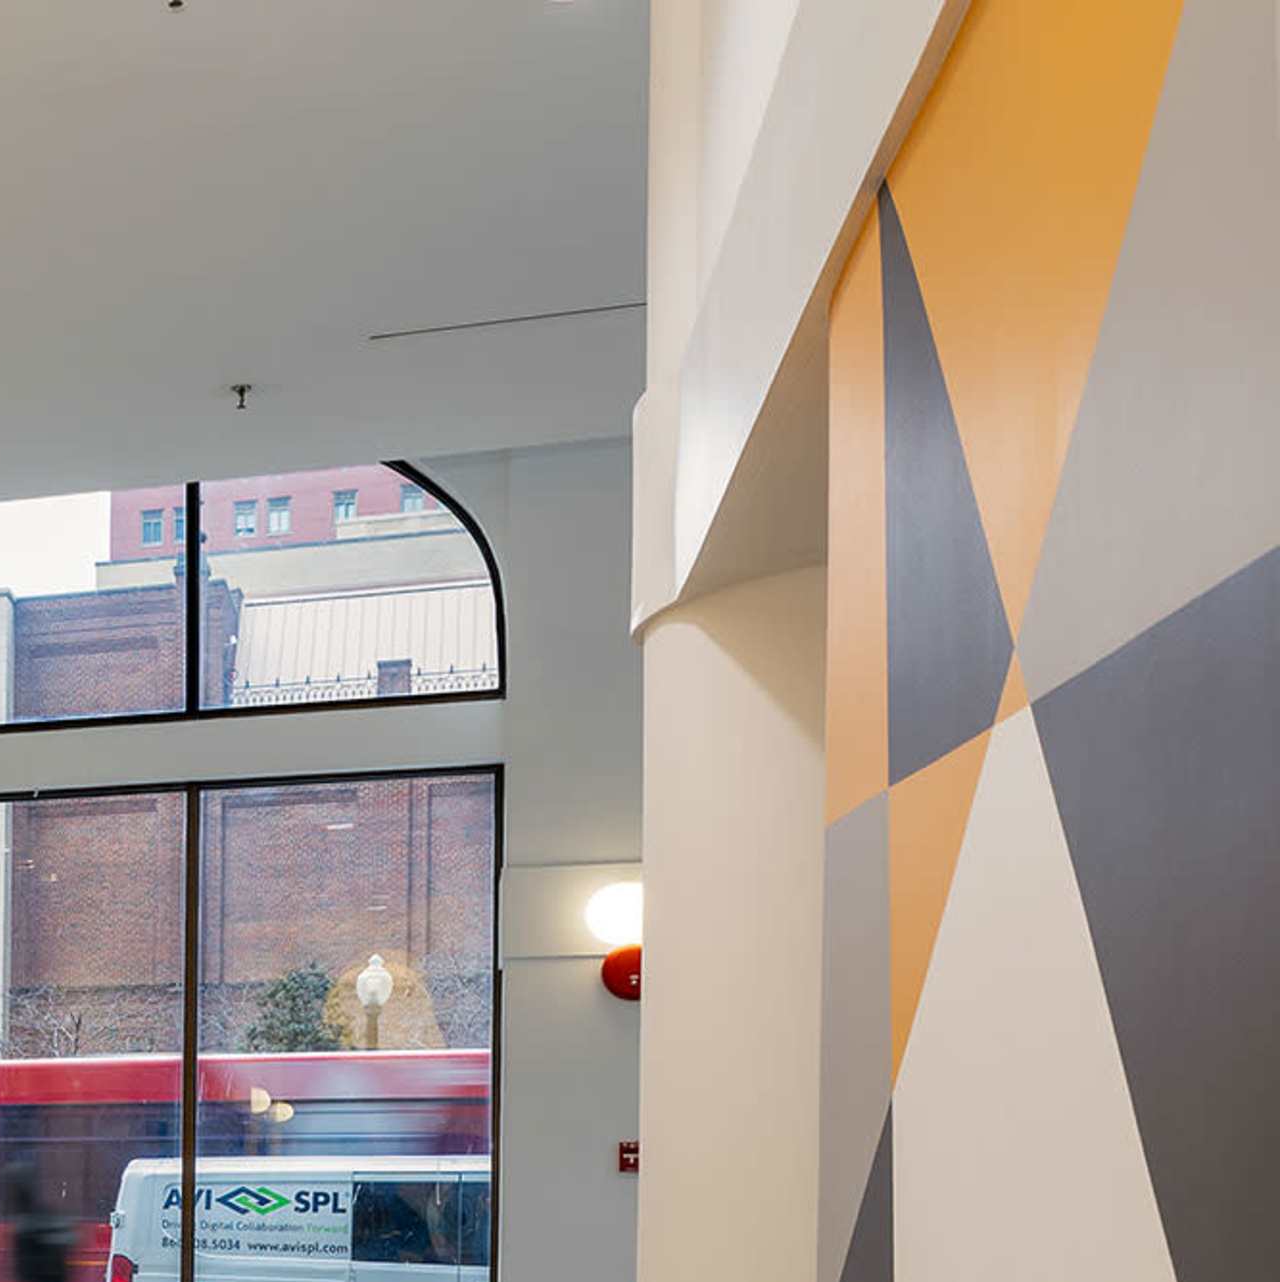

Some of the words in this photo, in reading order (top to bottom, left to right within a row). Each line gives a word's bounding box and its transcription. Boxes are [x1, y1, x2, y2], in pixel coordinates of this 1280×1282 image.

[293, 1190, 346, 1213] SPL
[200, 1220, 234, 1232] Digital
[236, 1221, 303, 1232] Collaboration
[305, 1222, 348, 1233] Forward
[247, 1240, 349, 1255] www.avispl.com
